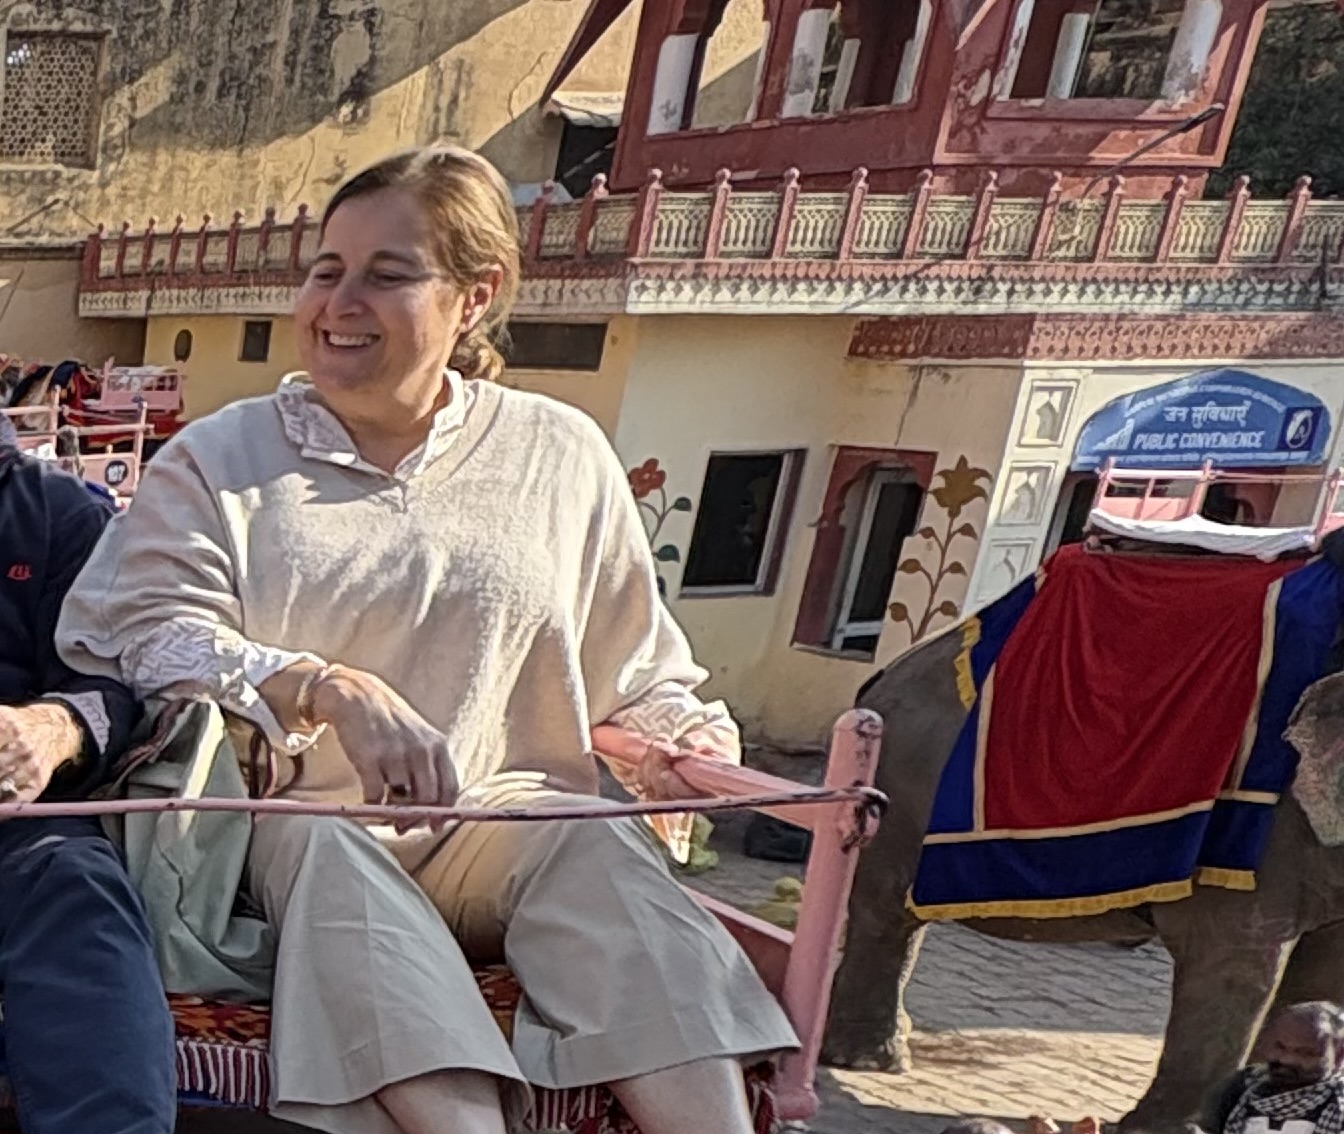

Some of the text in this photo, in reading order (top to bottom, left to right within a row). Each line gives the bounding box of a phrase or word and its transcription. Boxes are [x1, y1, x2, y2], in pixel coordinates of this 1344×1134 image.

[1163, 406, 1189, 422] जन
[1133, 430, 1266, 450] PUBLIC CONVENIENCE
